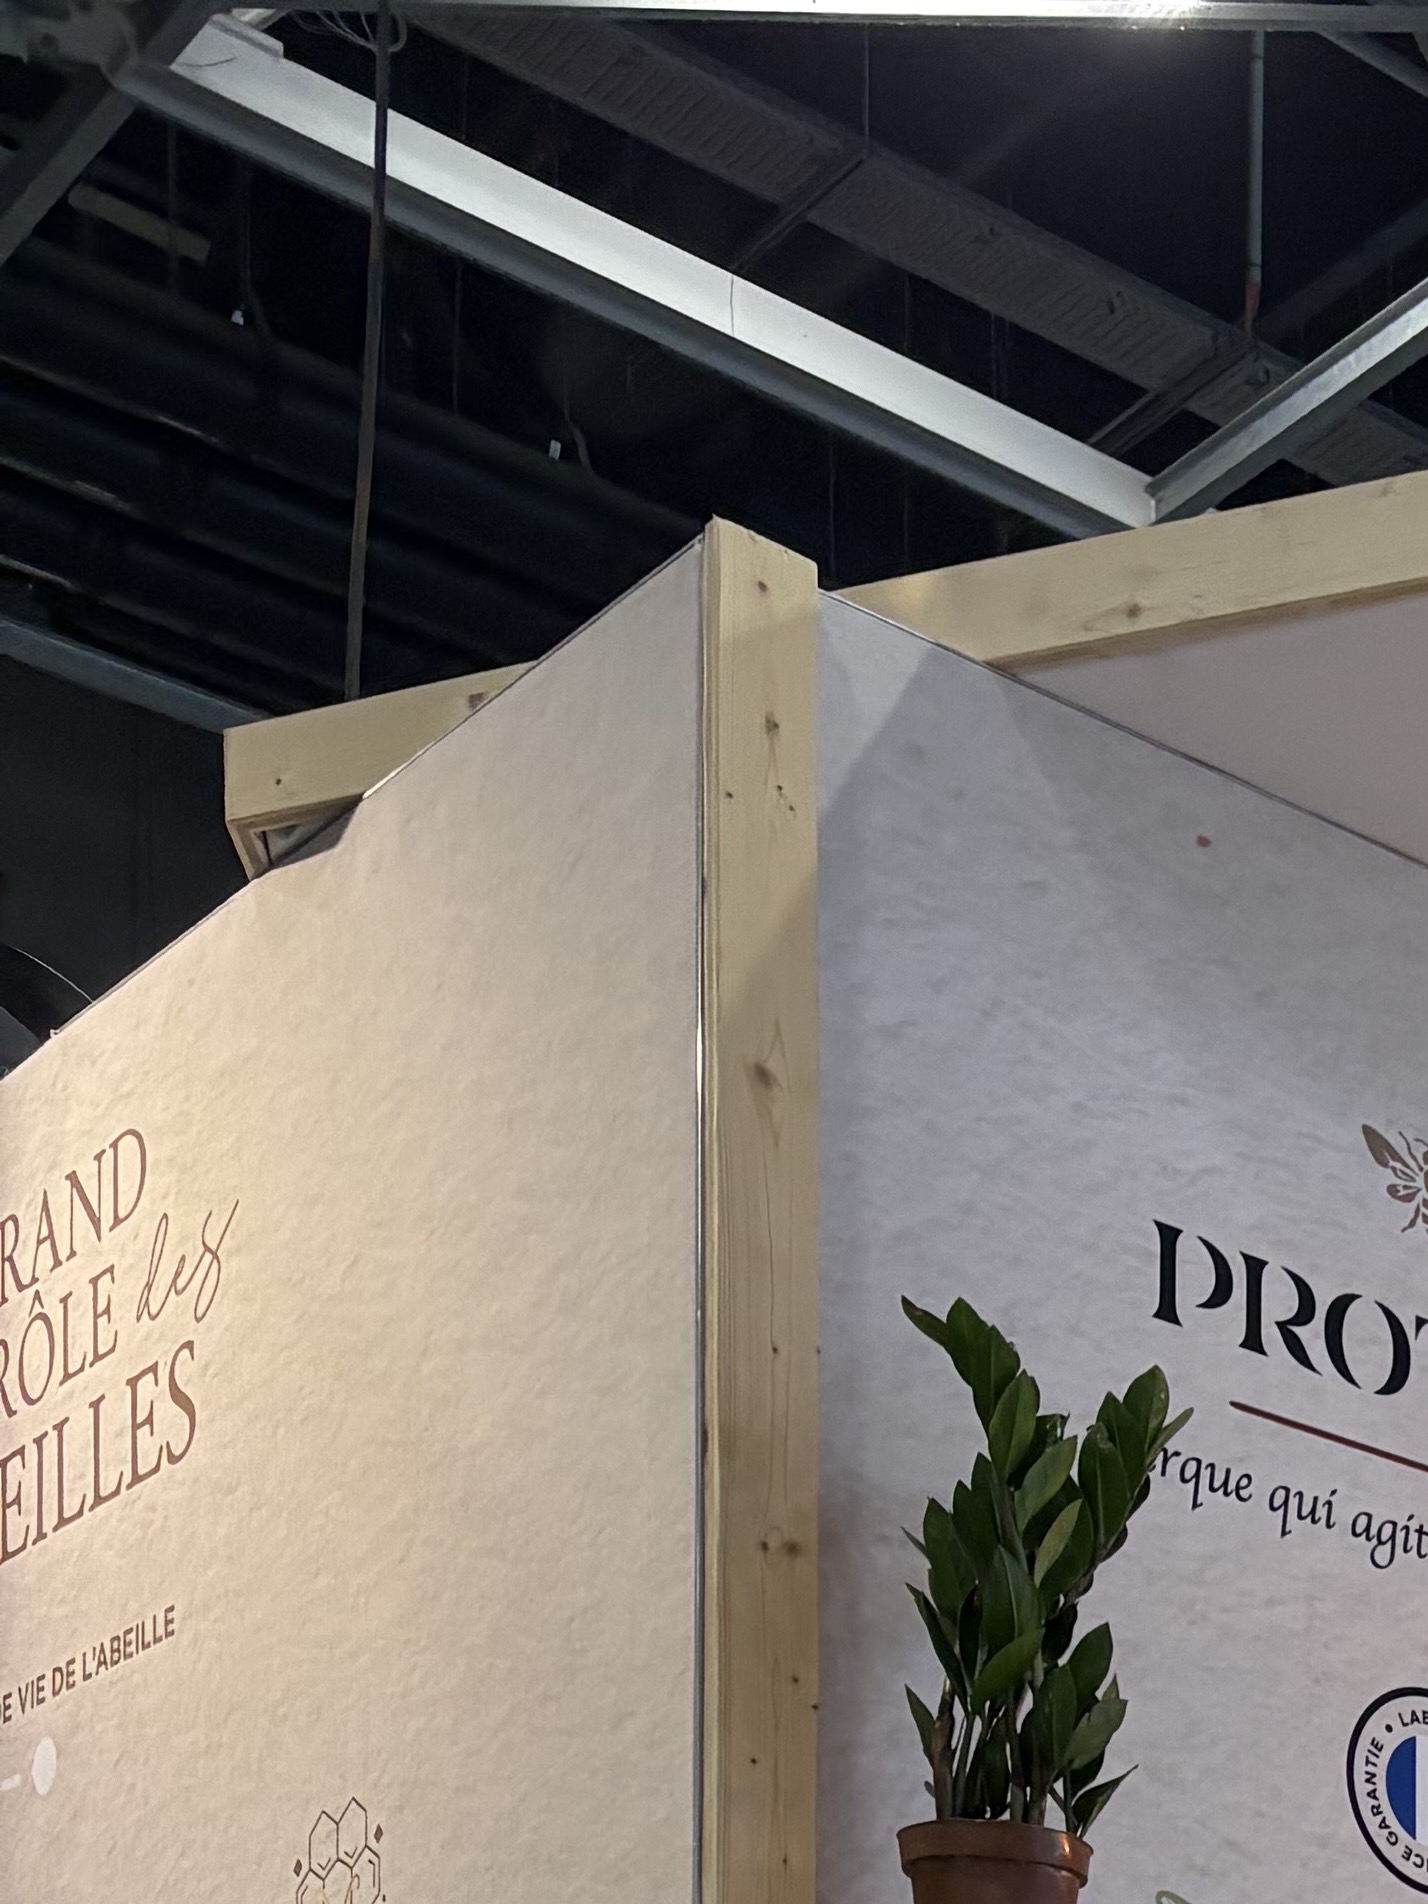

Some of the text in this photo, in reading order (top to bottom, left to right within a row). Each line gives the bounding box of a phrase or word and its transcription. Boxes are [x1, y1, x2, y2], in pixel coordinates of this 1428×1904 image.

[1148, 1447, 1253, 1511] rque
[1268, 1488, 1338, 1539] qui
[0, 1604, 175, 1725] E VIE DE L'ABEILLE
[1364, 1737, 1400, 1847] GARANTIE
